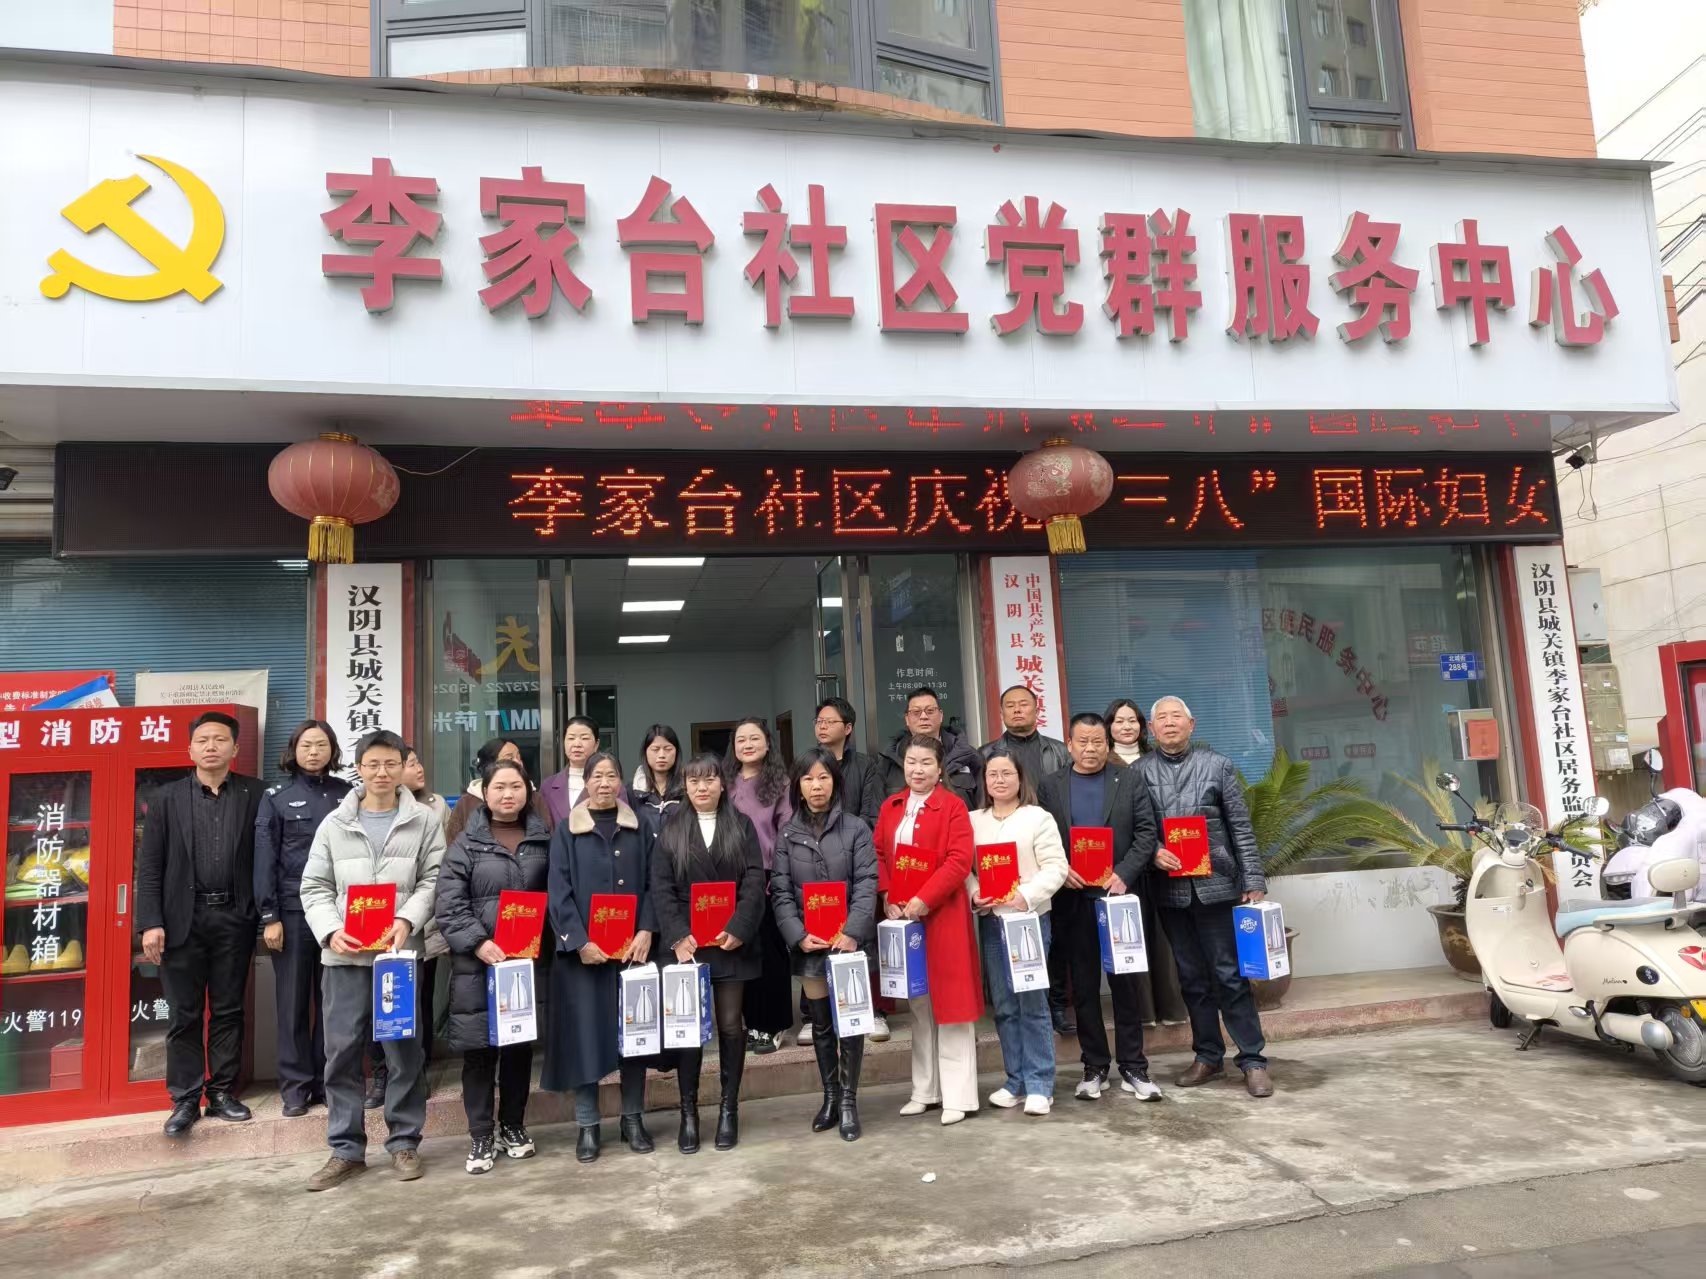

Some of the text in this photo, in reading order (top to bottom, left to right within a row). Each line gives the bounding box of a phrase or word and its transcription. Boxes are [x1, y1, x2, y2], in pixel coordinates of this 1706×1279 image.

[320, 157, 1620, 347] 李家台社区党群服务中心
[1025, 573, 1046, 647] 中国共产党
[31, 802, 65, 965] 消防器材箱
[3, 1009, 82, 1034] 火警119
[131, 998, 170, 1021] 火警
